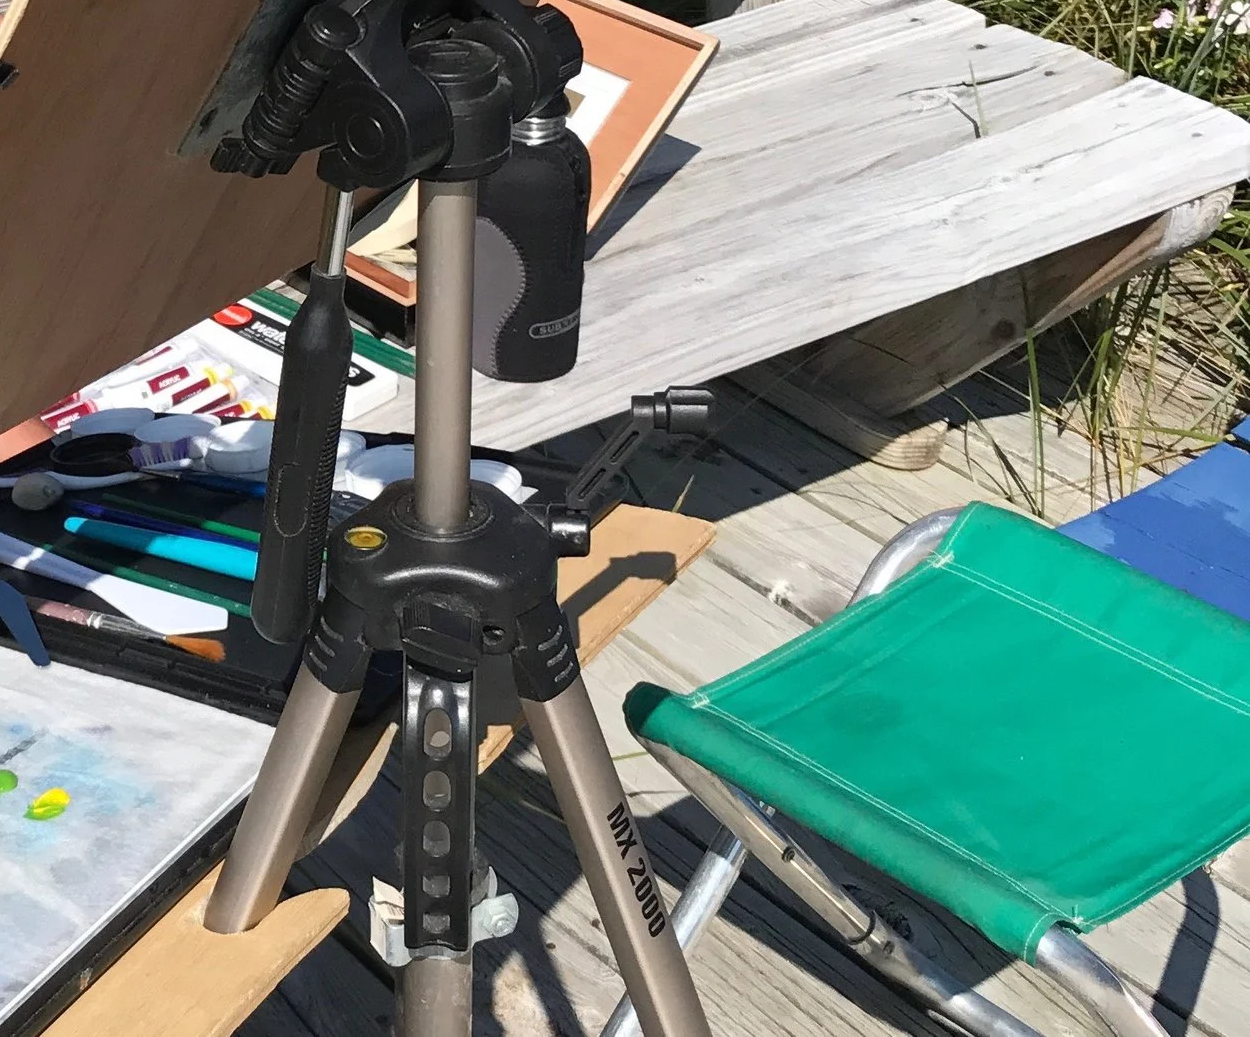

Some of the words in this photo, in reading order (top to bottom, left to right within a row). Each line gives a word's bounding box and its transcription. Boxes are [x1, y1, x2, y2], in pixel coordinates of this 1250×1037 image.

[158, 374, 182, 389] ACRYLIC
[606, 802, 638, 860] MX
[626, 857, 667, 938] 2000
